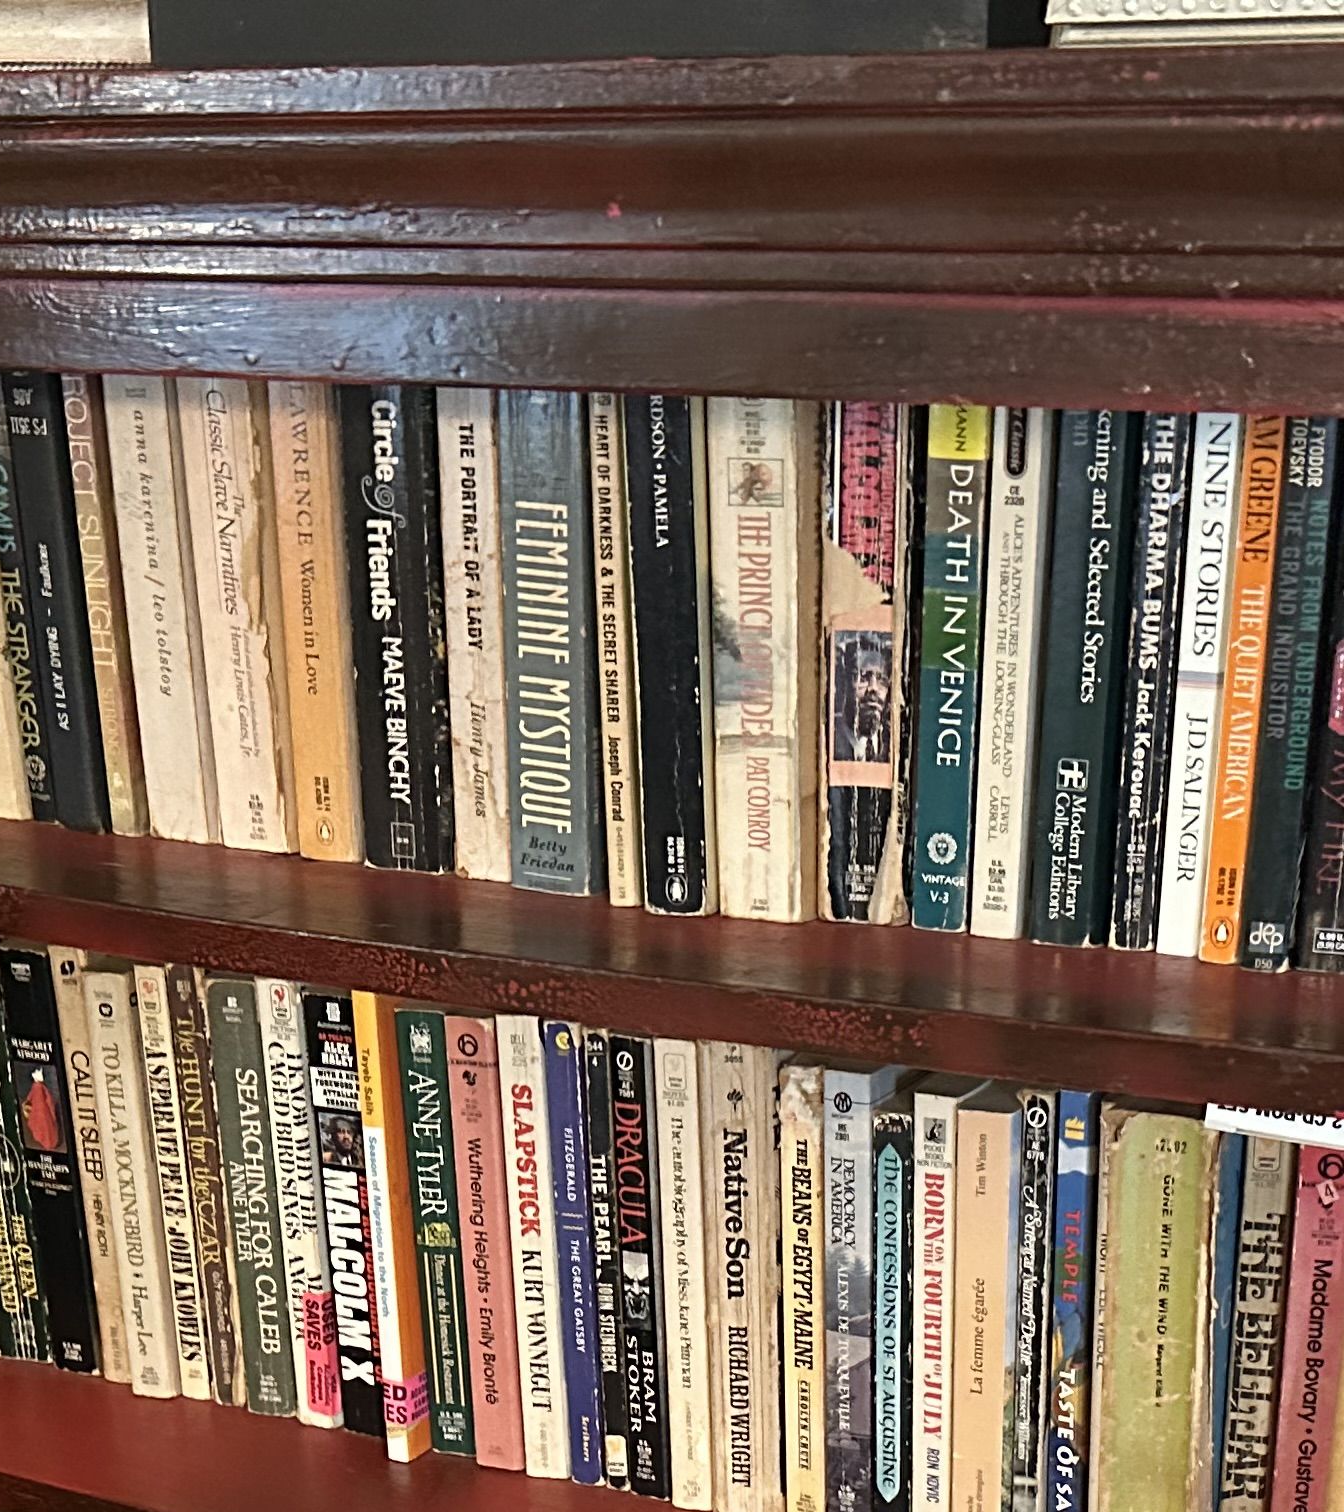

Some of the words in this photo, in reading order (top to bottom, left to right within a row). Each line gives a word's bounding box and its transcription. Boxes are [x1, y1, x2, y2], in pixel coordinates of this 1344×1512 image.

[132, 409, 148, 463] anna
[370, 400, 395, 482] Circle
[459, 424, 475, 459] THE
[1205, 419, 1234, 507] NINE
[141, 473, 158, 569] karenina
[460, 467, 479, 549] PORTRAIT
[946, 465, 974, 583] DEATH
[0, 569, 19, 606] THE
[301, 559, 317, 625] Women
[366, 520, 393, 621] Friends
[464, 558, 480, 583] OF
[464, 589, 481, 601] A
[515, 500, 571, 663] FEMININE
[1192, 519, 1224, 657] STORIES
[152, 590, 167, 622] leo
[467, 605, 483, 651] LADY
[945, 597, 972, 633] IN
[156, 629, 173, 696] tolstoy
[301, 632, 315, 649] in
[4, 611, 40, 749] STRANGER
[303, 651, 318, 695] Love
[382, 637, 407, 724] MAEVE
[937, 645, 965, 767] VENICE
[385, 722, 411, 805] BINCHY
[518, 676, 573, 833] MYSTIQUE
[528, 836, 567, 855] Betty
[1051, 793, 1073, 859] College
[1072, 796, 1088, 848] Modern
[1176, 756, 1207, 883] SALINGER
[520, 852, 575, 872] Friedan
[922, 874, 964, 887] VINTAGE
[1048, 861, 1064, 920] Editions
[1062, 852, 1079, 920] Library
[70, 1051, 91, 1106] CALL
[78, 1109, 95, 1127] IT
[235, 1068, 267, 1221] SEARCHING
[81, 1127, 104, 1181] SLEEP
[468, 1137, 484, 1232] Wuthering
[510, 1083, 541, 1237] SLAPSTICK
[614, 1100, 648, 1244] DRACULA
[723, 1128, 750, 1232] Native
[975, 1133, 988, 1174] Winton
[113, 1135, 143, 1267] MOCKINGBIRD
[975, 1177, 988, 1197] Tim
[251, 1225, 273, 1271] FOR
[322, 1168, 372, 1342] MALCOLM
[474, 1233, 489, 1292] Heights
[521, 1249, 545, 1306] KURT
[569, 1239, 582, 1261] THE
[724, 1237, 750, 1299] Son
[1060, 1211, 1080, 1304] TEMPLE
[571, 1264, 584, 1300] GREAT
[973, 1277, 987, 1317] égarée
[1305, 1259, 1333, 1352] Madame
[255, 1277, 282, 1355] CALEB
[479, 1308, 493, 1348] Emily
[574, 1303, 586, 1352] GATSBY
[971, 1323, 984, 1372] femme
[340, 1355, 374, 1385] X
[484, 1353, 498, 1404] Brontë
[525, 1310, 553, 1412] VONNEGUT
[625, 1334, 643, 1432] STOKER
[641, 1350, 657, 1422] BRAM
[728, 1326, 752, 1412] RICHARD
[970, 1377, 984, 1396] La
[1297, 1360, 1325, 1424] Bovary
[1055, 1369, 1078, 1438] TASTE
[728, 1415, 752, 1486] WRIGHT
[1055, 1443, 1076, 1477] OF
